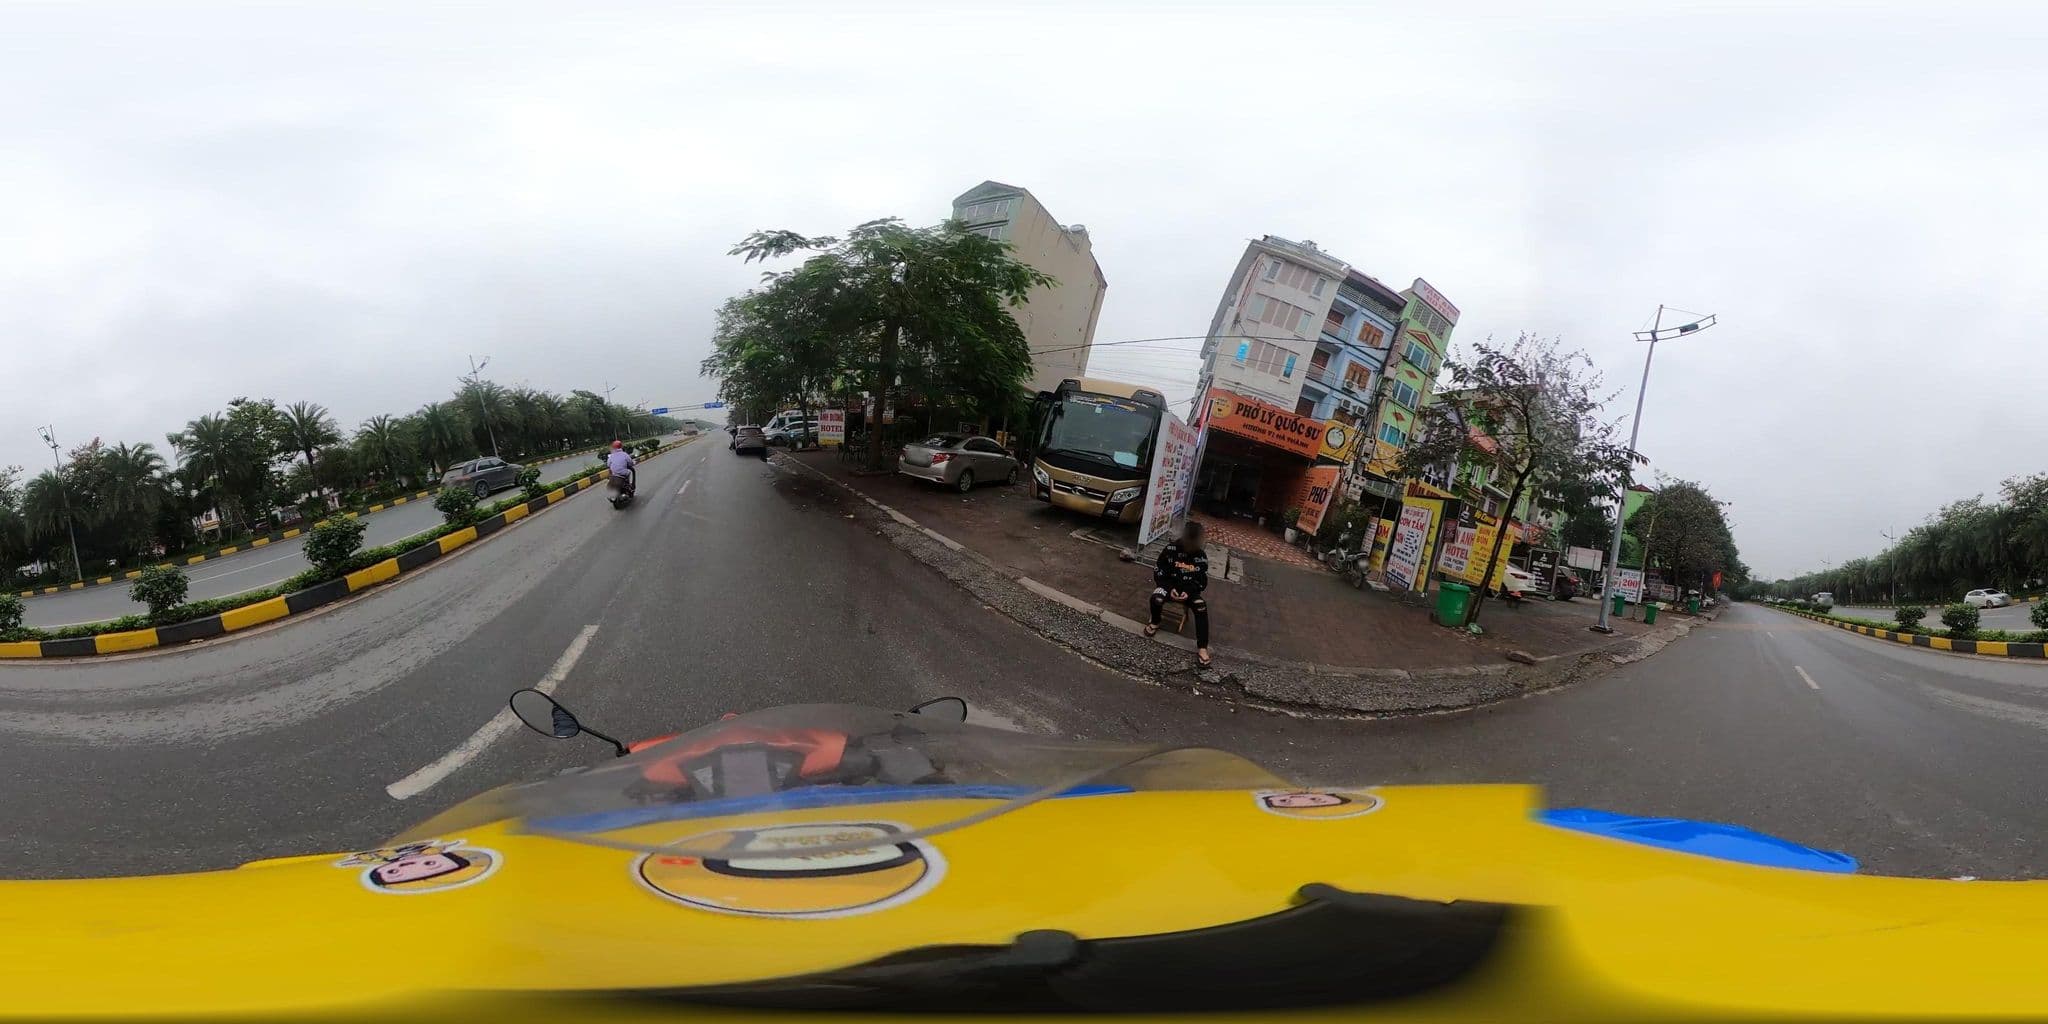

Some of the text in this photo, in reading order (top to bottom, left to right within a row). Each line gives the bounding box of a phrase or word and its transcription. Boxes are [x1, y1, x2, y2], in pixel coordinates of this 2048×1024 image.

[1235, 401, 1260, 421] PHỞ
[1260, 409, 1276, 425] LÝ
[1275, 416, 1306, 434] QUỐC
[1306, 425, 1323, 441] SƯ
[1308, 481, 1330, 505] PHỞ
[1445, 546, 1469, 560] HOTEL
